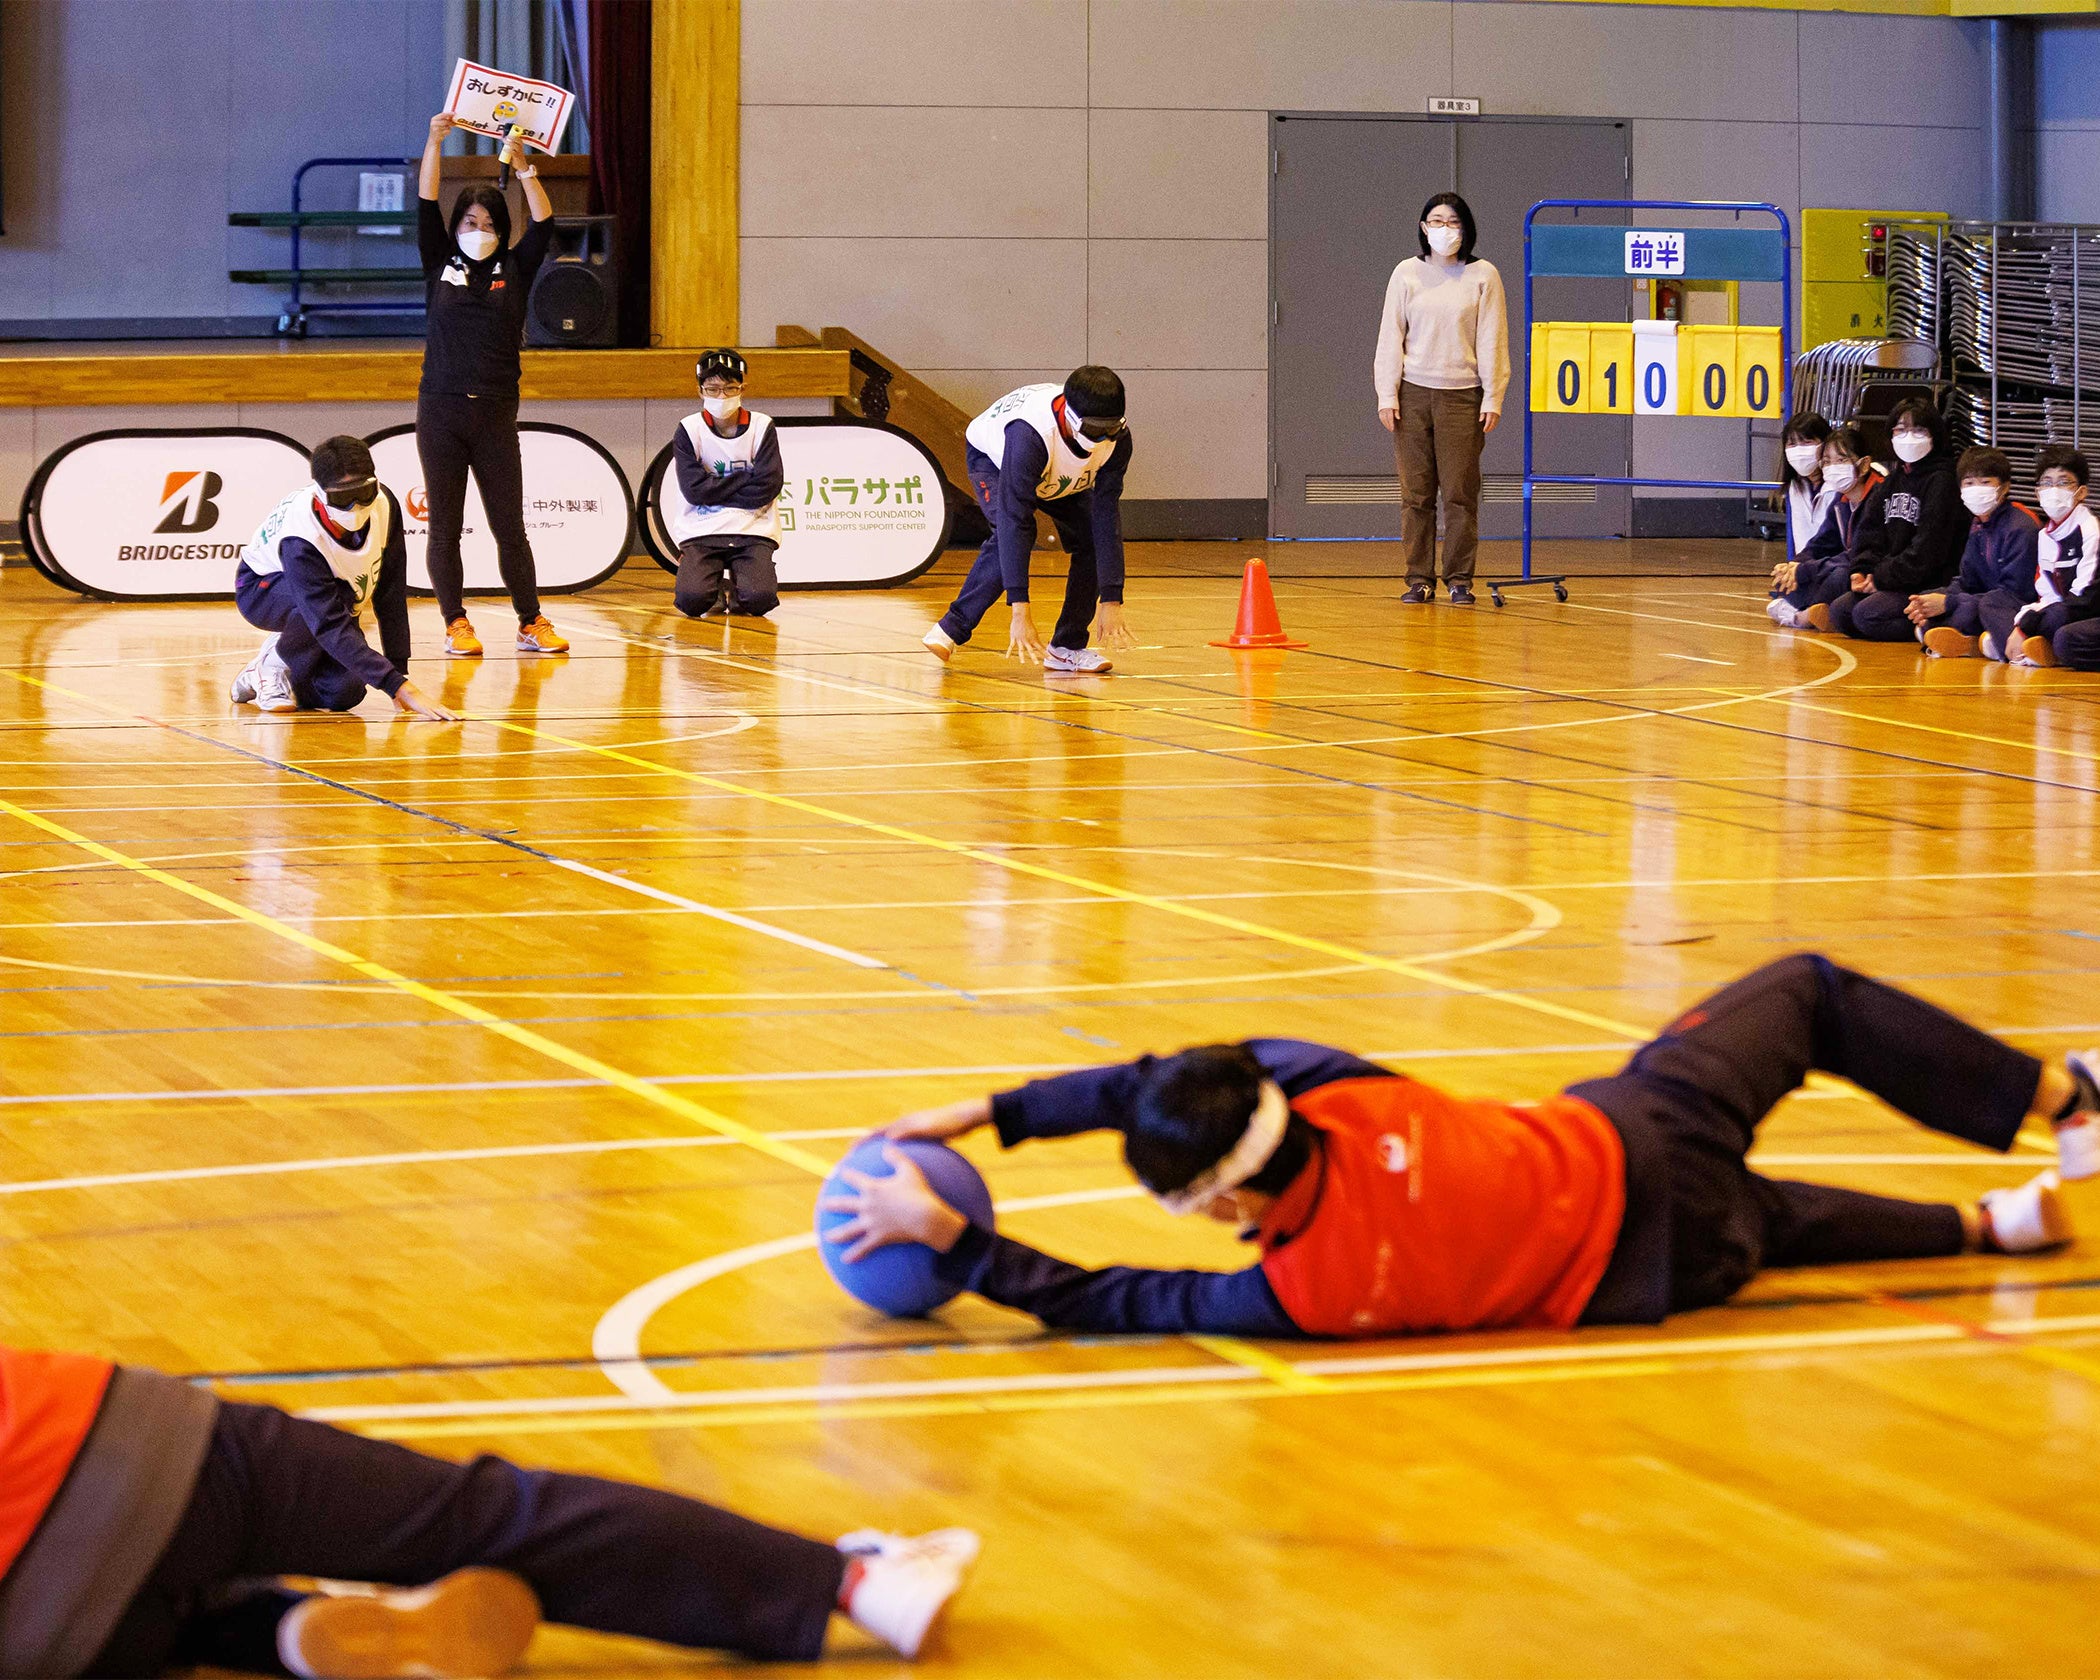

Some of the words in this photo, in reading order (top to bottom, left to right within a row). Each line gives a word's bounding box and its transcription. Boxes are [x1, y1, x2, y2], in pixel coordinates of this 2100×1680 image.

[1437, 101, 1471, 111] 器具室3
[1630, 239, 1679, 269] 前半
[1850, 314, 1883, 328] 消火
[804, 475, 924, 506] パラサポ
[532, 500, 598, 512] 中外製薬
[805, 511, 821, 519] THE
[824, 511, 861, 519] NIPPON
[864, 510, 925, 519] FOUNDATION
[118, 544, 247, 561] BRIDGESTO
